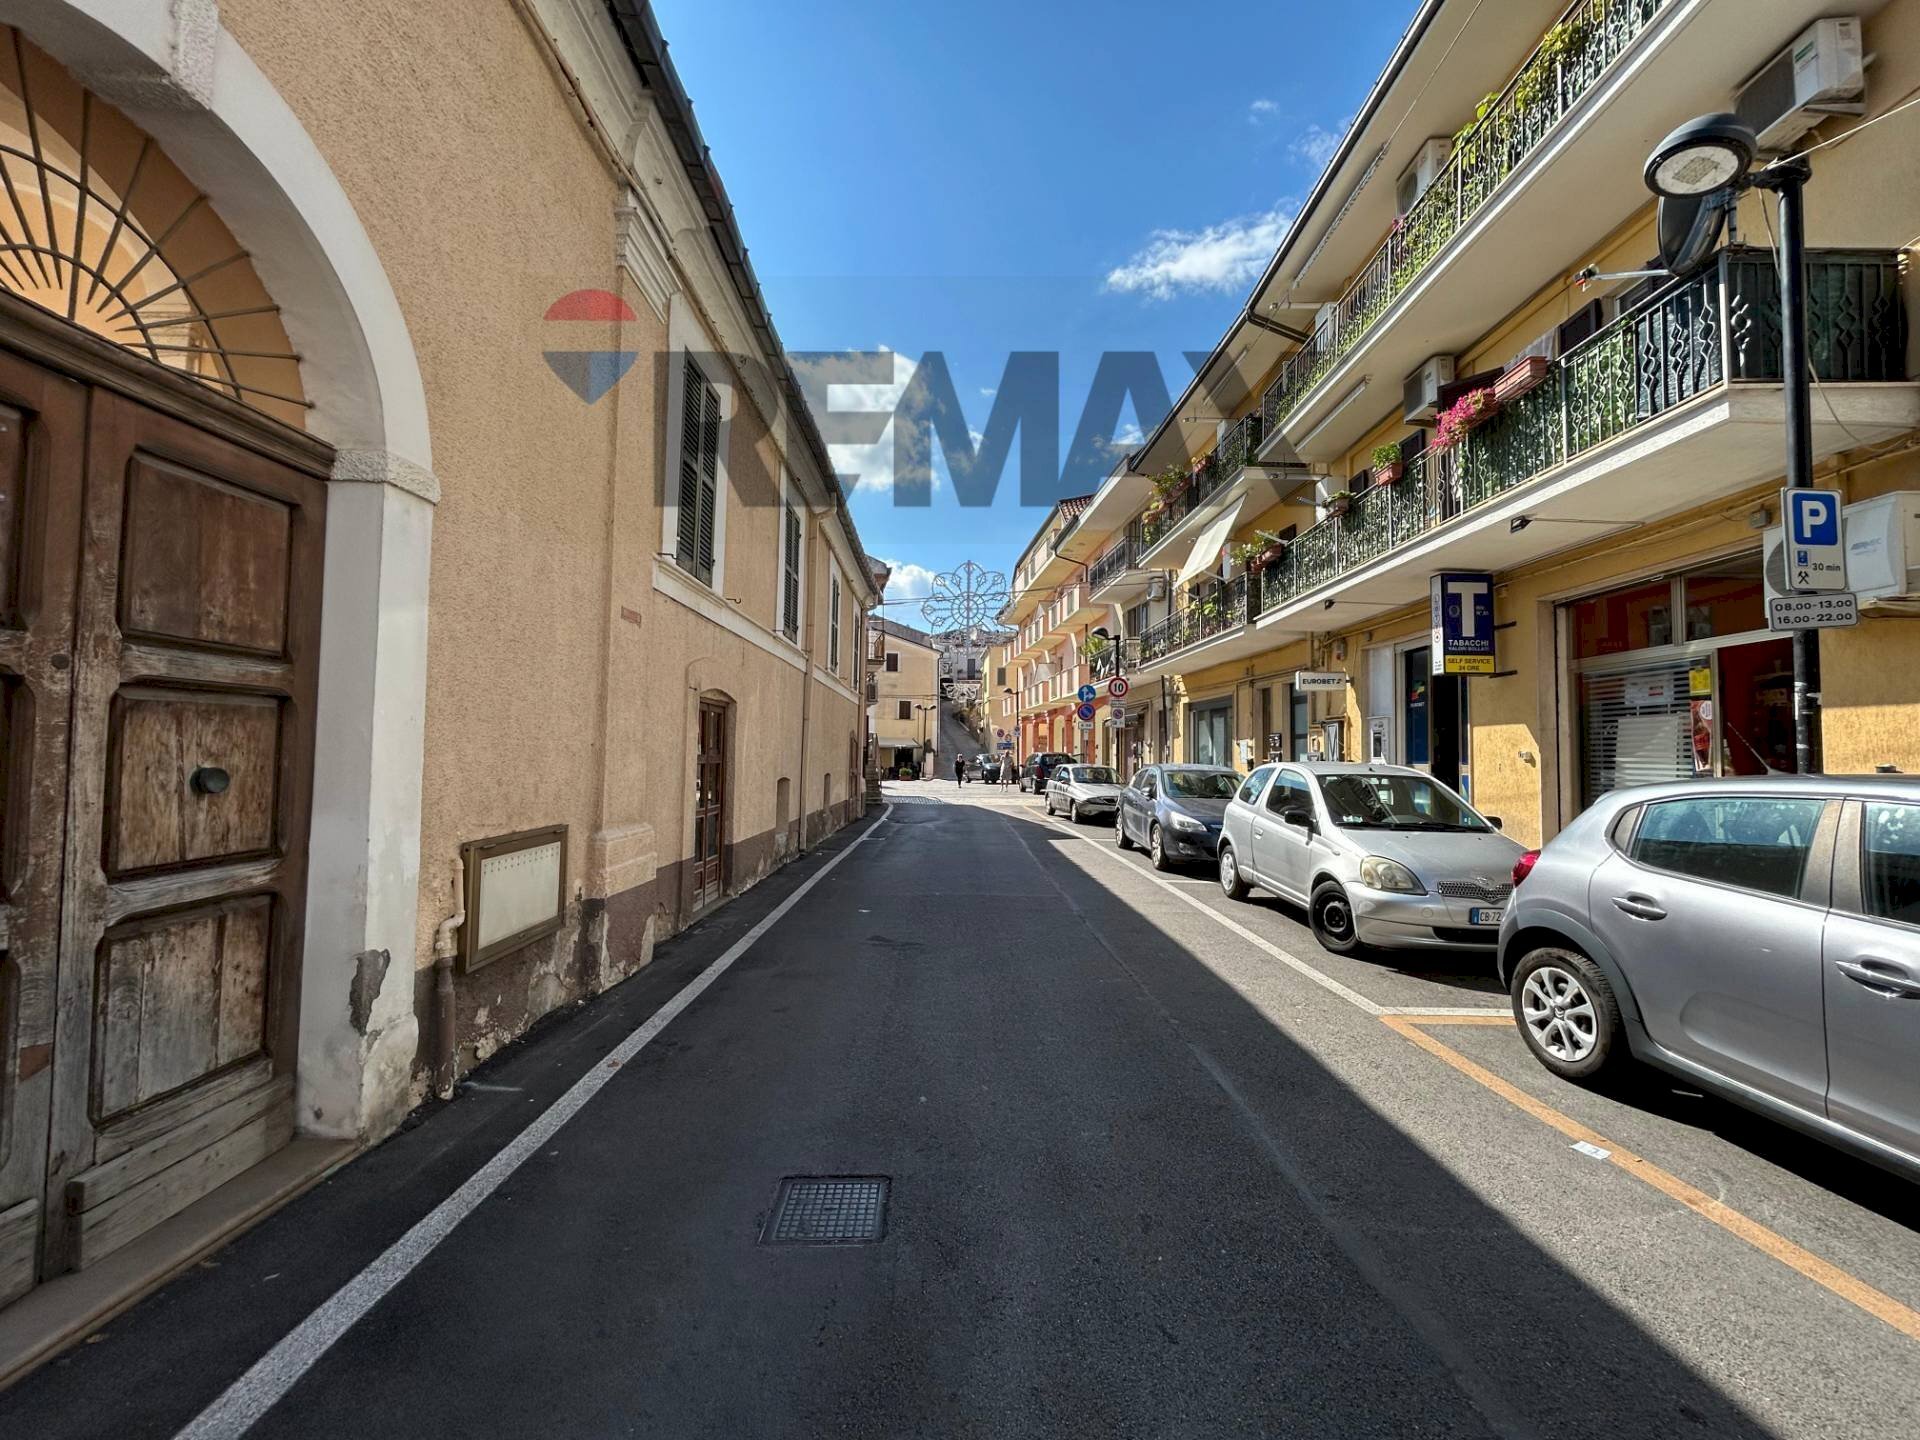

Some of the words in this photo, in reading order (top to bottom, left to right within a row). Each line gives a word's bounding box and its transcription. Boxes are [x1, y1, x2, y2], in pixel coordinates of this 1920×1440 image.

[1802, 500, 1827, 538] P
[1812, 563, 1824, 571] 30
[1447, 582, 1488, 637] T
[1775, 600, 1852, 612] 08.00-13.00
[1777, 613, 1852, 624] 16.00-22.00
[1114, 683, 1123, 692] 10
